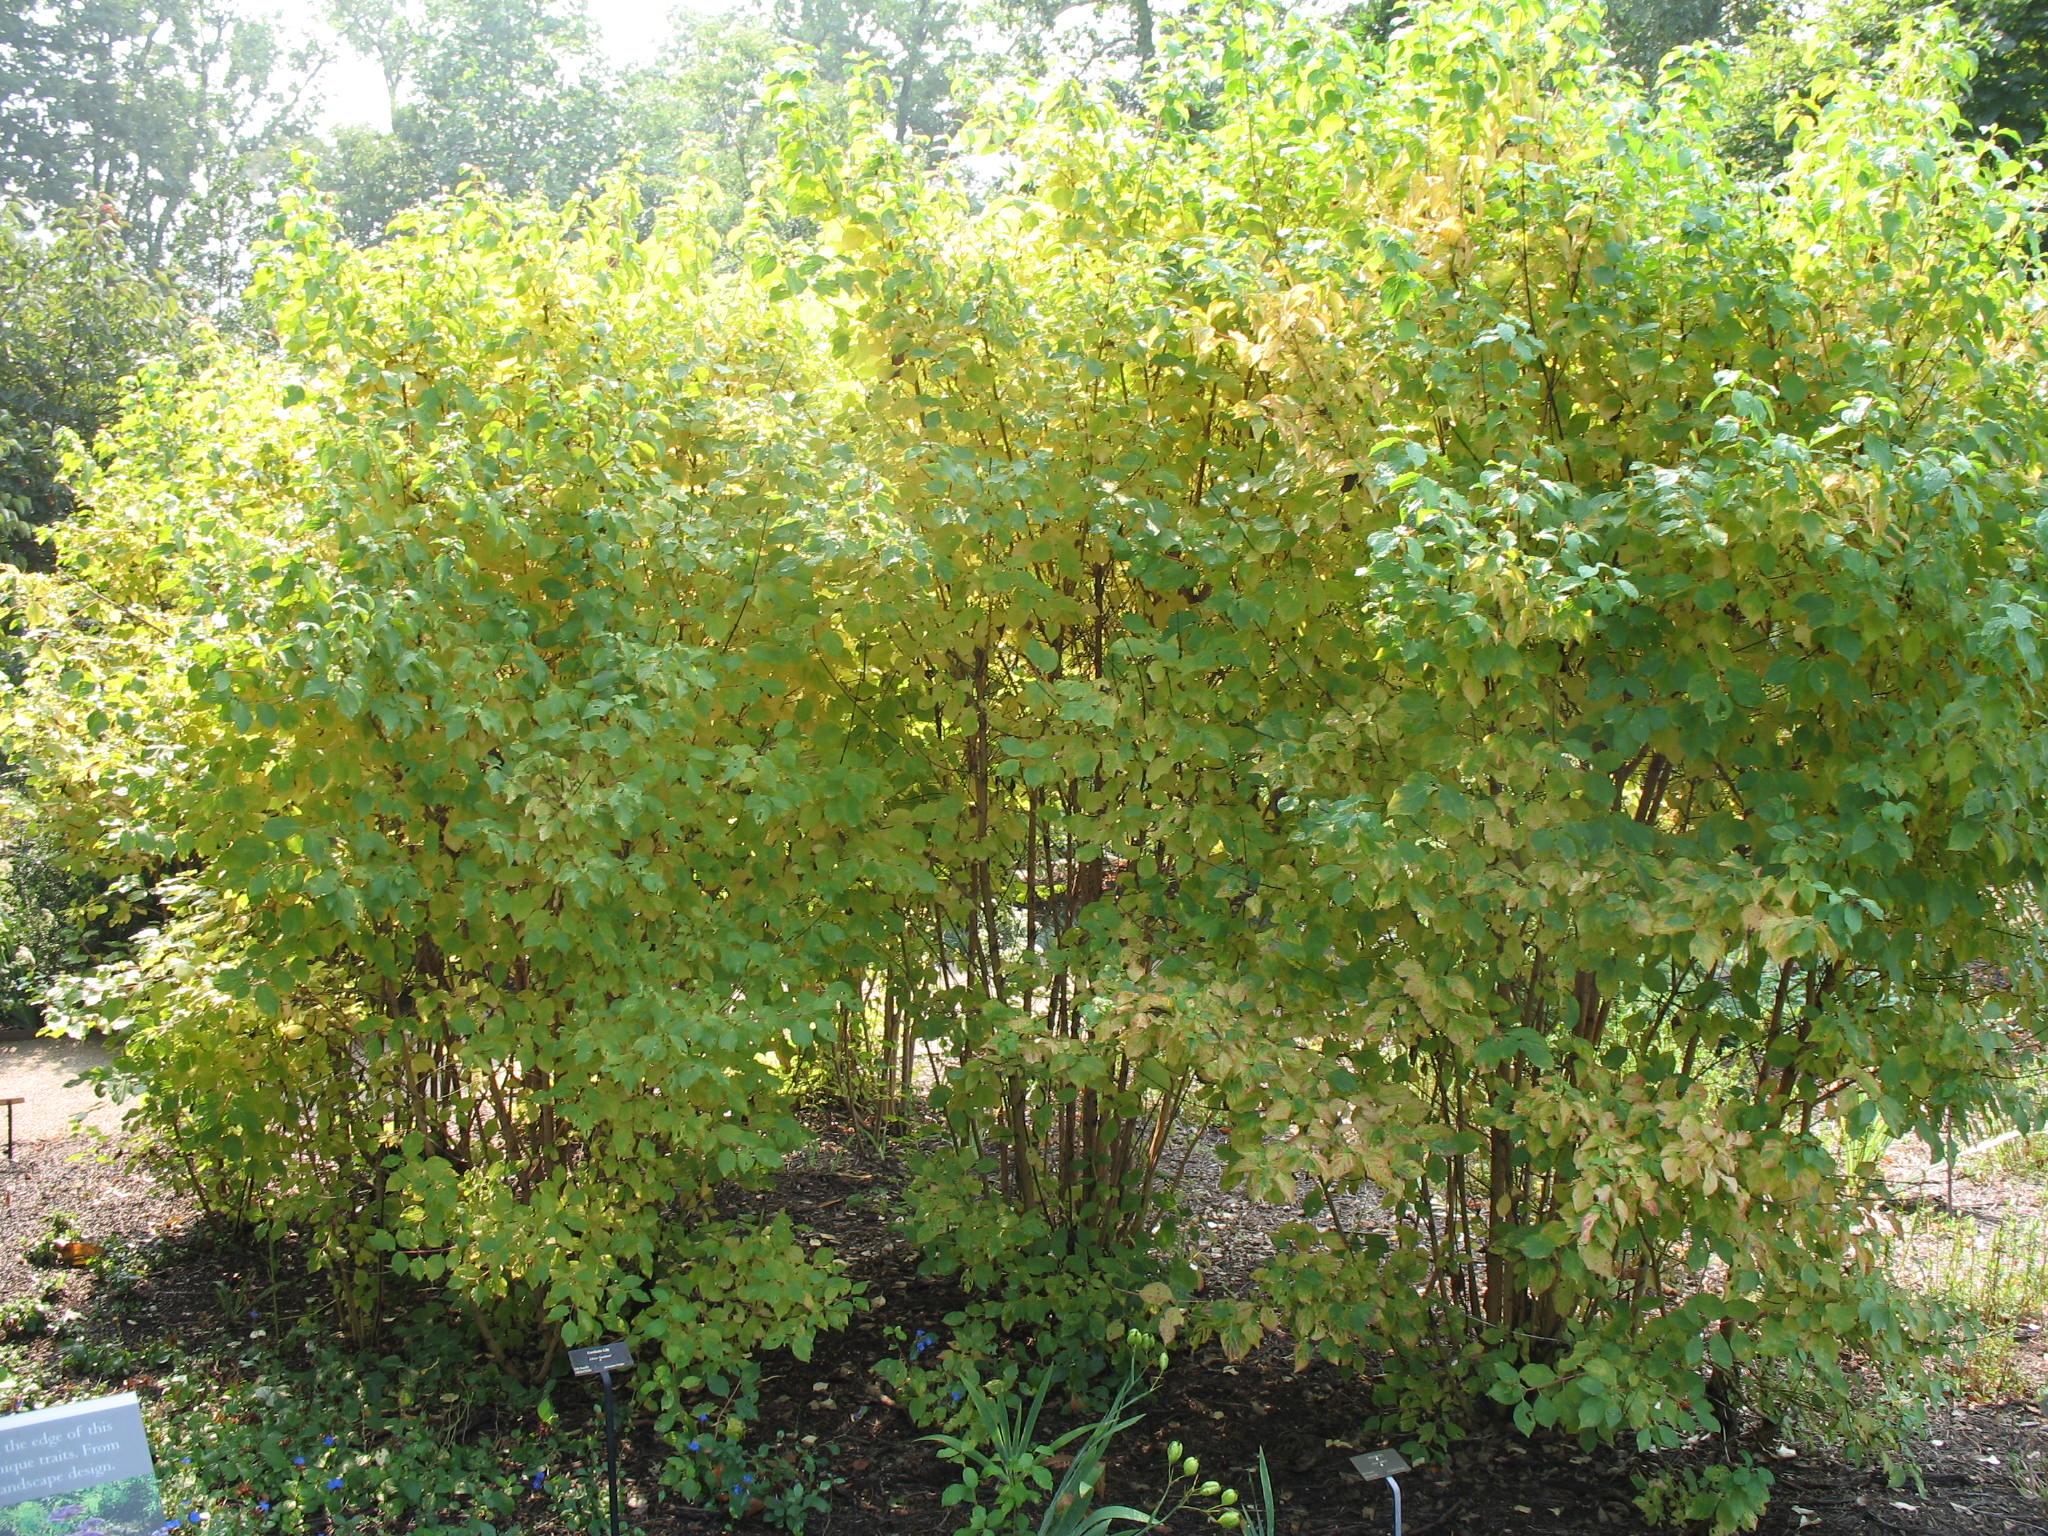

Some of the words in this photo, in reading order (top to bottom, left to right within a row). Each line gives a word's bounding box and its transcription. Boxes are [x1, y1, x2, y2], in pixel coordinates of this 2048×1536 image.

[5, 1440, 27, 1453] the
[32, 1432, 62, 1447] edge
[67, 1425, 83, 1439] of
[88, 1421, 113, 1434] this
[82, 1440, 120, 1456] From
[68, 1462, 116, 1480] design.
